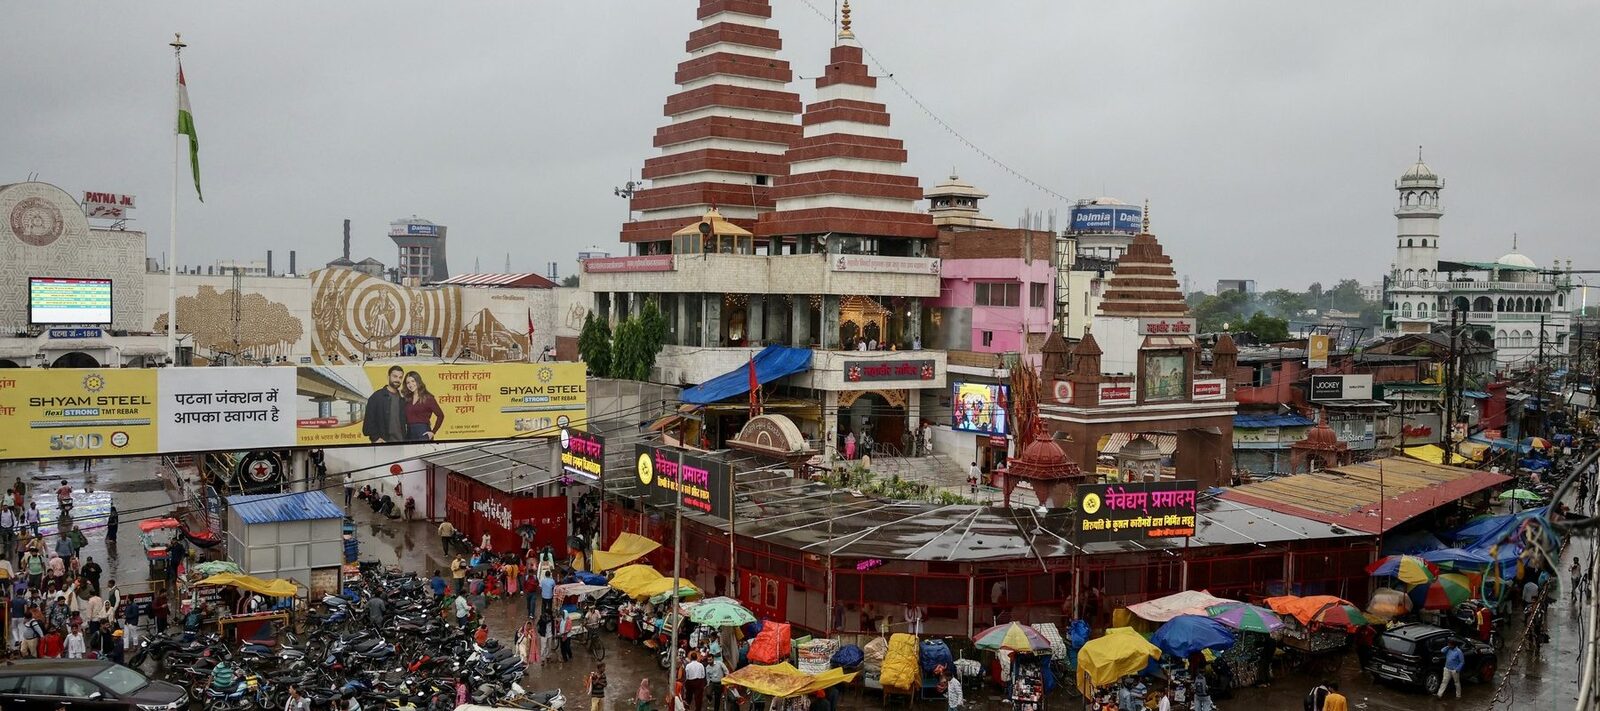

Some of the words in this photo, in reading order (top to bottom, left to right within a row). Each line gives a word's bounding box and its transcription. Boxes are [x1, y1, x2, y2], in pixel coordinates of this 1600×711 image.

[86, 191, 116, 204] PATNA
[1076, 213, 1111, 222] Dalmia
[52, 329, 67, 338] पटना
[452, 383, 478, 391] मतलब
[500, 386, 543, 395] SHYAM
[547, 385, 586, 393] STEEL
[29, 396, 90, 406] SHYAM
[97, 395, 151, 405] STEEL
[175, 393, 212, 405] पटना
[215, 390, 263, 404] जंक्शन
[266, 388, 279, 402] में
[463, 392, 473, 402] के
[475, 393, 491, 403] लिए
[64, 408, 99, 416] STRONG
[175, 411, 221, 424] आपका
[223, 409, 268, 422] स्वागत
[270, 405, 280, 422] है
[514, 416, 551, 431] 550D
[50, 433, 103, 450] 550D
[1105, 486, 1148, 515] नैवेद्यम्
[1151, 490, 1196, 513] प्रसादम्
[1105, 518, 1111, 529] के
